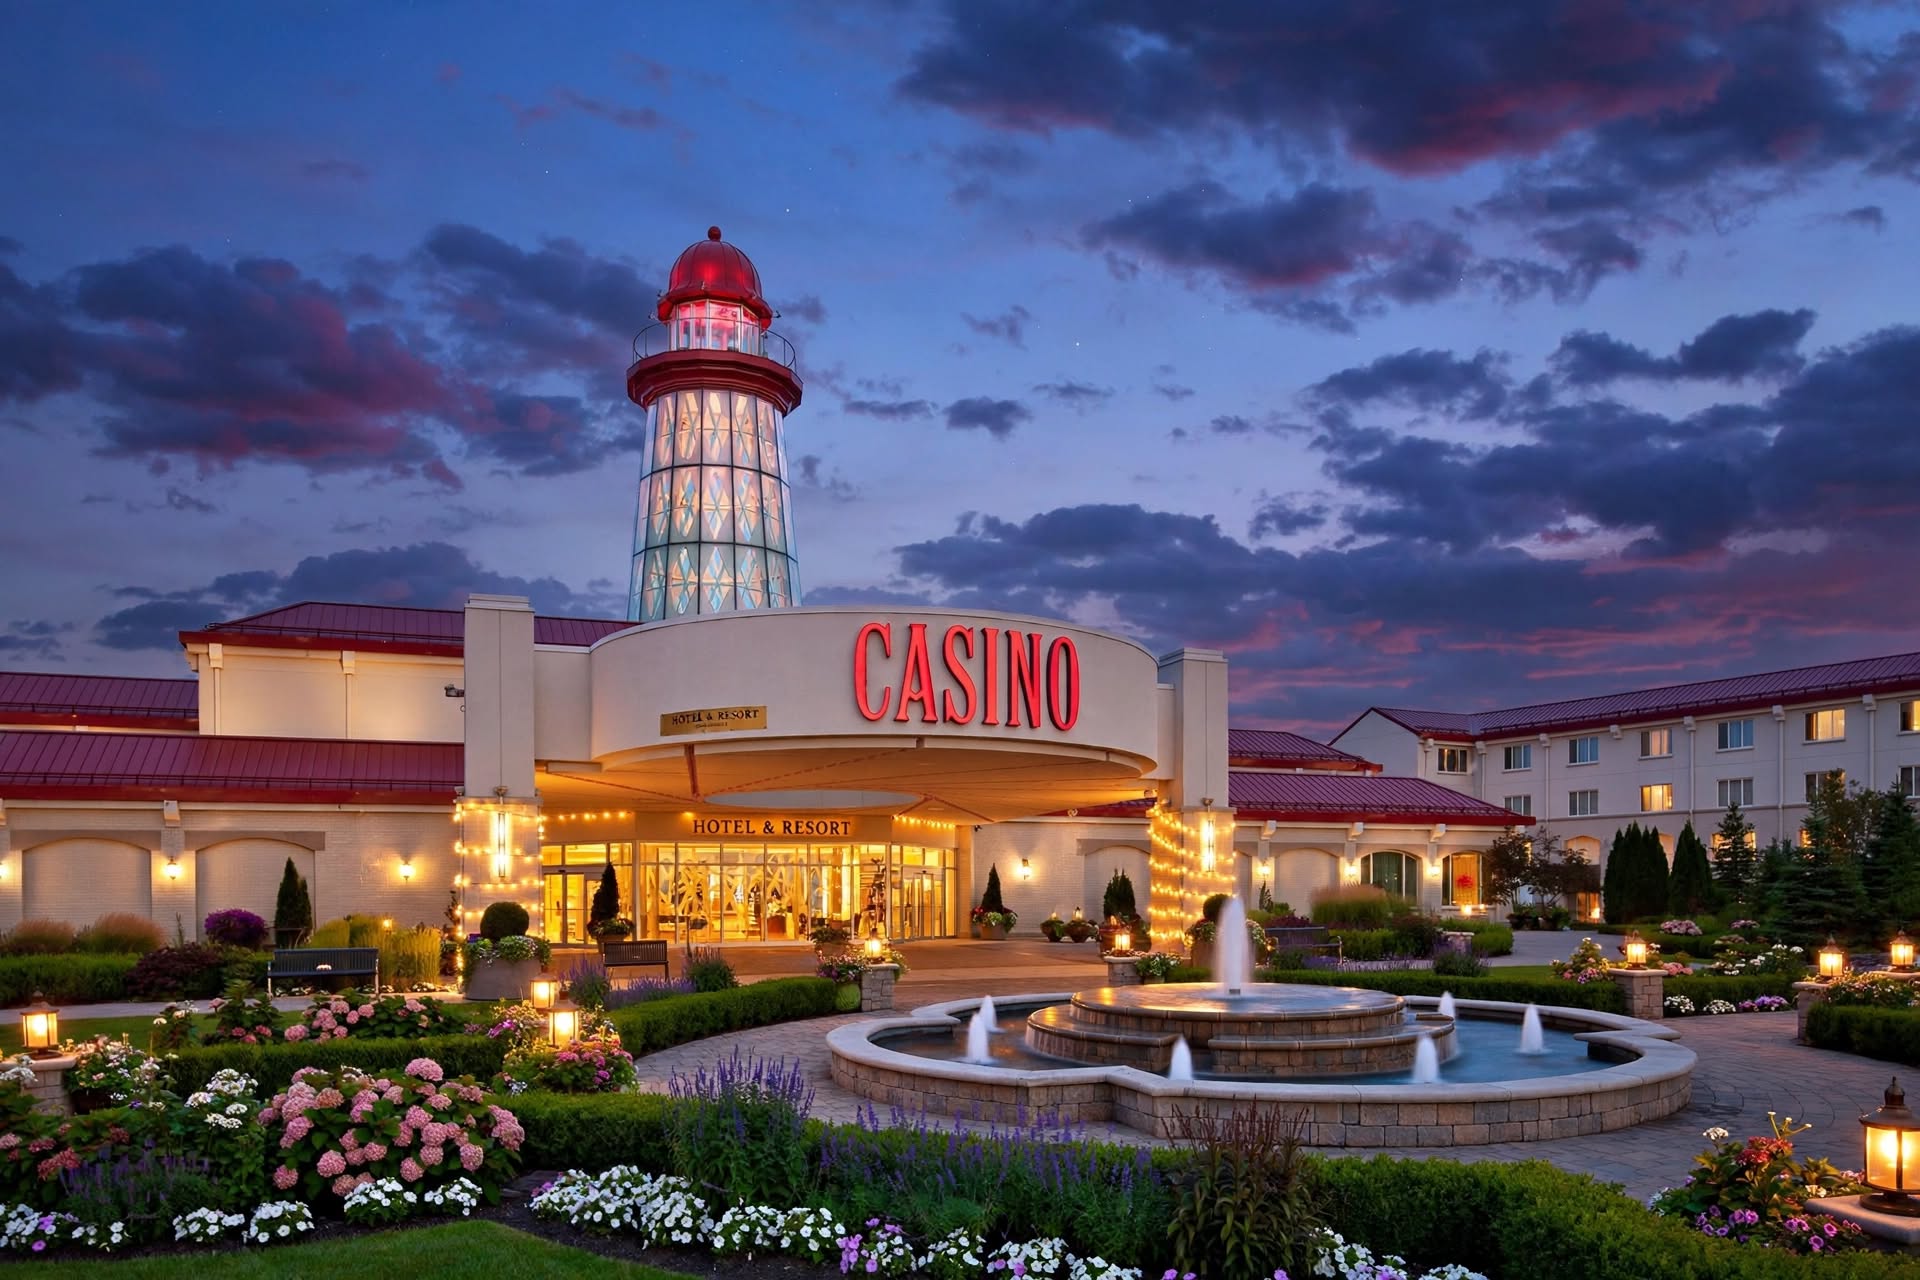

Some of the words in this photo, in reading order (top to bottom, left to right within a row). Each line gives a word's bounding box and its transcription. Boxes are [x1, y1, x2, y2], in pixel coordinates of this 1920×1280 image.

[854, 622, 1080, 731] CASINO
[672, 711, 702, 725] HOTEL
[706, 712, 713, 721] &
[718, 709, 759, 721] RESORT
[693, 819, 755, 834] HOTEL
[763, 820, 774, 835] &
[782, 820, 850, 835] RESORT
